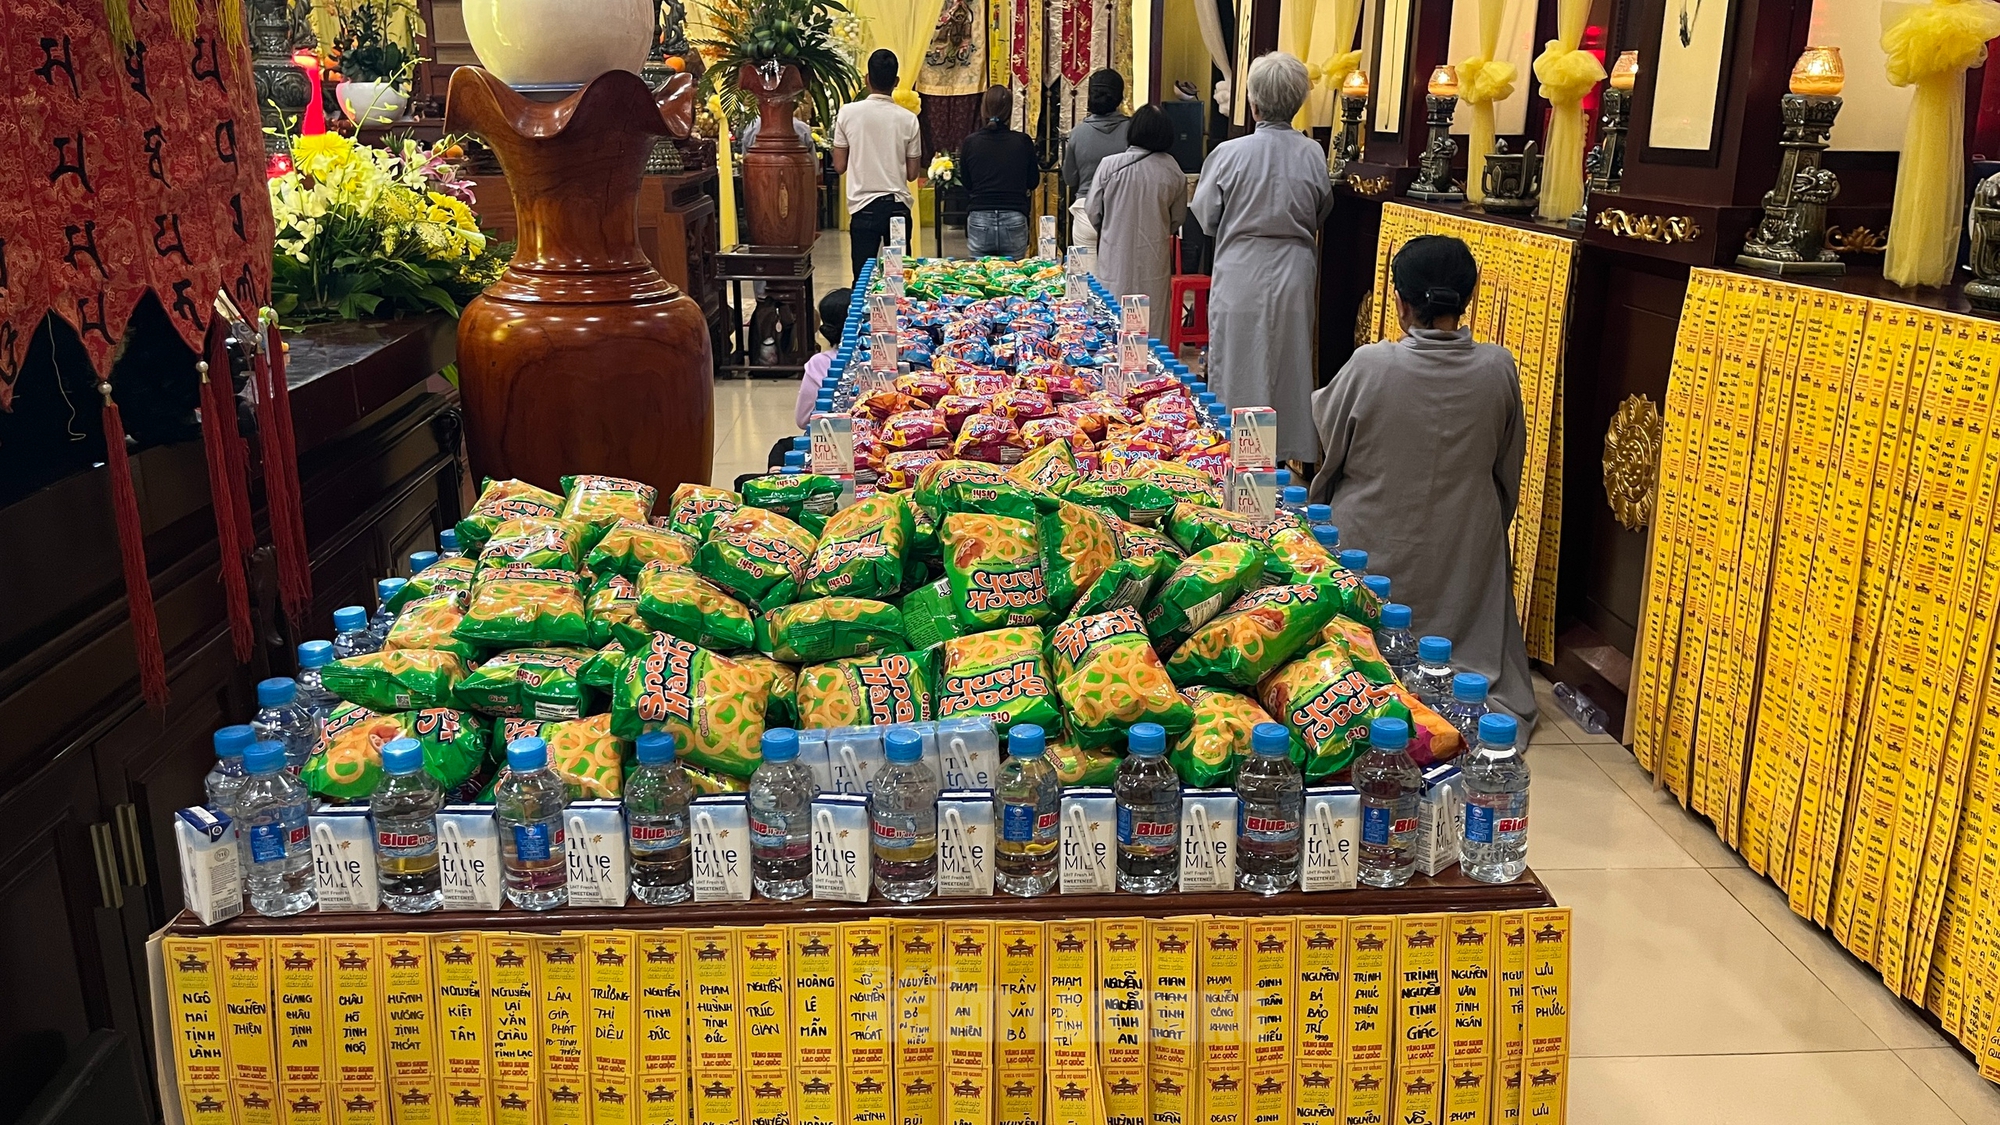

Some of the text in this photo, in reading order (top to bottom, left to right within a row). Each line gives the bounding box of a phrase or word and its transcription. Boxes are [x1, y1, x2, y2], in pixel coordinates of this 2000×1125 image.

[946, 661, 1035, 698] Hành
[1135, 821, 1174, 837] Blue
[1246, 815, 1287, 832] Blue
[379, 831, 420, 848] Blue
[631, 825, 666, 841] Blue
[1118, 1034, 1137, 1045] AN
